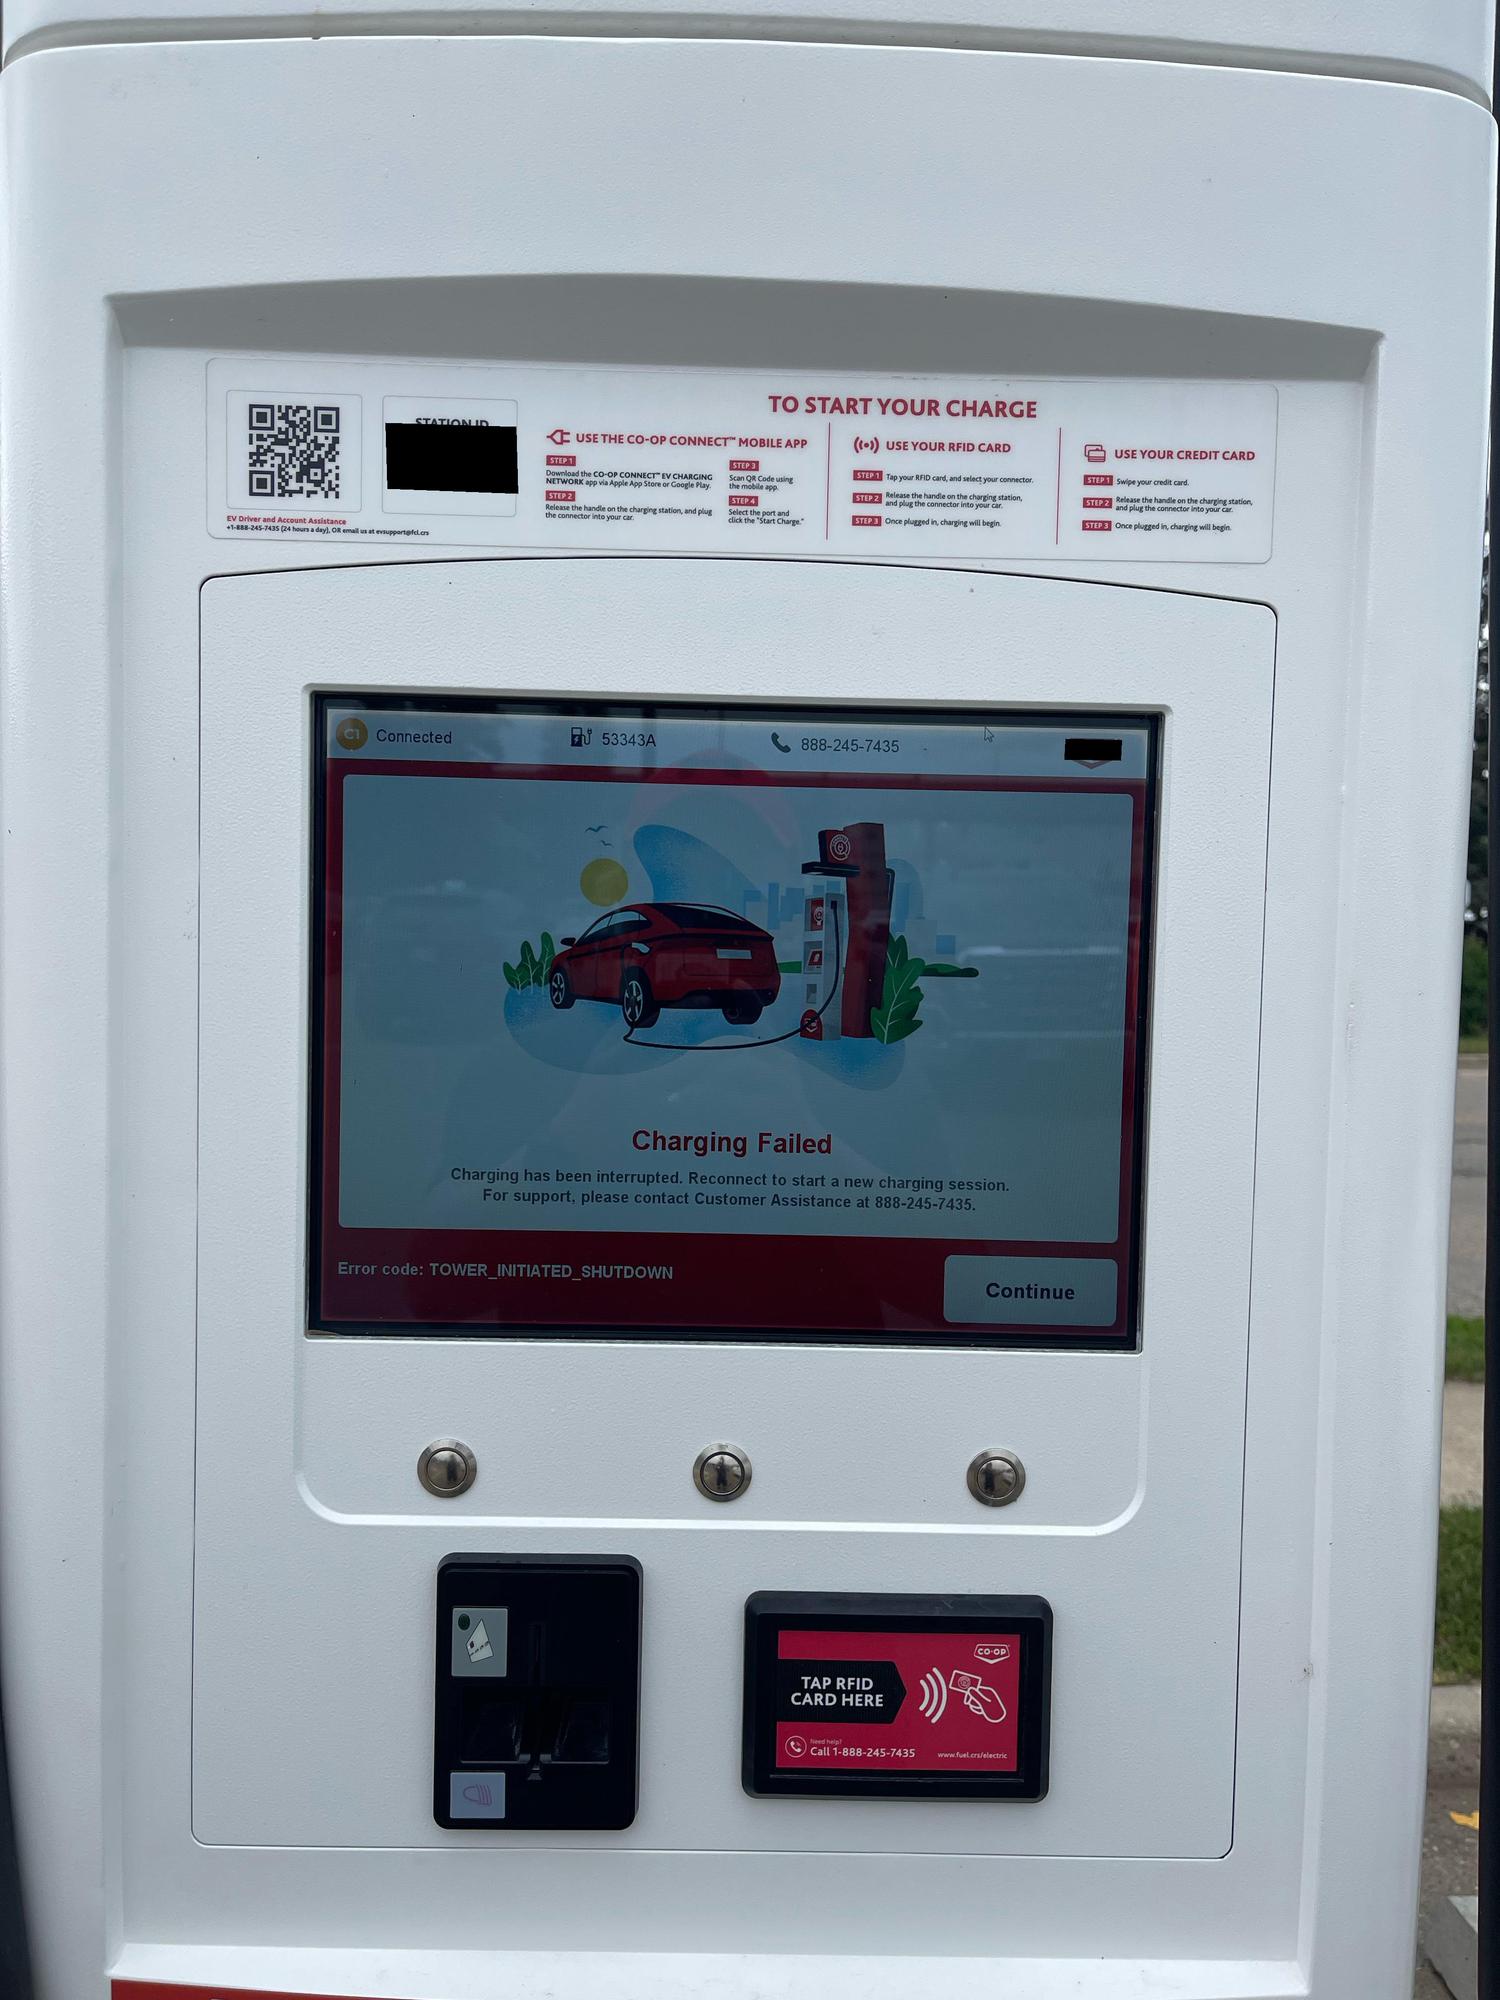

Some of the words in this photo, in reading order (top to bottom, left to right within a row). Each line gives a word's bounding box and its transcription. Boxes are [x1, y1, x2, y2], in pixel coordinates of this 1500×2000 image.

[768, 395, 799, 413] TO
[804, 396, 873, 414] START
[876, 398, 940, 416] YOUR
[946, 399, 1037, 418] CHARGE
[576, 433, 598, 443] USE
[600, 434, 624, 444] THE
[626, 434, 666, 445] CO-OP
[738, 438, 782, 448] MOBILE
[784, 439, 807, 448] APP
[886, 441, 908, 450] USE
[910, 441, 945, 451] YOUR
[948, 442, 975, 452] RFID
[978, 442, 1011, 452] CARD
[1114, 449, 1137, 459] USE
[1139, 449, 1174, 459] YOUR
[1176, 450, 1220, 460] CREDIT
[1222, 450, 1255, 460] CARD
[546, 469, 579, 478] Download
[745, 475, 757, 484] QR
[775, 476, 793, 484] using
[886, 473, 898, 482] Tap
[609, 479, 628, 488] Apple
[628, 480, 642, 488] App
[670, 481, 694, 490] Google
[1116, 478, 1136, 487] Swipe
[545, 504, 570, 512] Release
[571, 504, 582, 513] the
[583, 504, 606, 513] handle
[628, 506, 657, 515] charging
[697, 508, 712, 516] plug
[749, 508, 760, 517] the
[777, 510, 790, 518] and
[903, 518, 930, 527] plugged
[940, 518, 968, 527] charging
[1133, 522, 1160, 531] plugged
[1170, 523, 1198, 532] charging
[376, 729, 452, 744] Connected
[600, 732, 656, 749] 53343A
[801, 738, 899, 752] 888-245-7435
[632, 1130, 746, 1157] Charging
[758, 1132, 831, 1154] Failed
[450, 1167, 518, 1184] Charging
[524, 1168, 550, 1181] has
[555, 1169, 591, 1182] been
[596, 1170, 682, 1186] interrupted.
[688, 1172, 767, 1185] Reconnect
[772, 1174, 786, 1186] to
[792, 1174, 826, 1186] start
[831, 1178, 839, 1187] a
[844, 1178, 874, 1188] new
[878, 1176, 943, 1192] charging
[948, 1178, 1009, 1191] session.
[483, 1188, 509, 1201] For
[513, 1190, 575, 1205] support,
[581, 1190, 628, 1205] please
[634, 1192, 689, 1204] contact
[694, 1192, 766, 1206] Customer
[770, 1193, 851, 1207] Assistance
[856, 1196, 870, 1208] at
[875, 1196, 975, 1210] 888-245-7435.
[337, 1261, 378, 1275] Error
[382, 1262, 423, 1277] code:
[429, 1263, 672, 1280] TOWER_INITIATED_SHUTDOWN
[986, 1282, 1074, 1300] Continue
[800, 1676, 831, 1689] TAP
[836, 1677, 873, 1690] RFID
[790, 1692, 836, 1706] CARD
[841, 1693, 883, 1706] HERE
[810, 1747, 830, 1756] Call
[832, 1747, 916, 1758] 1-888-245-7435
